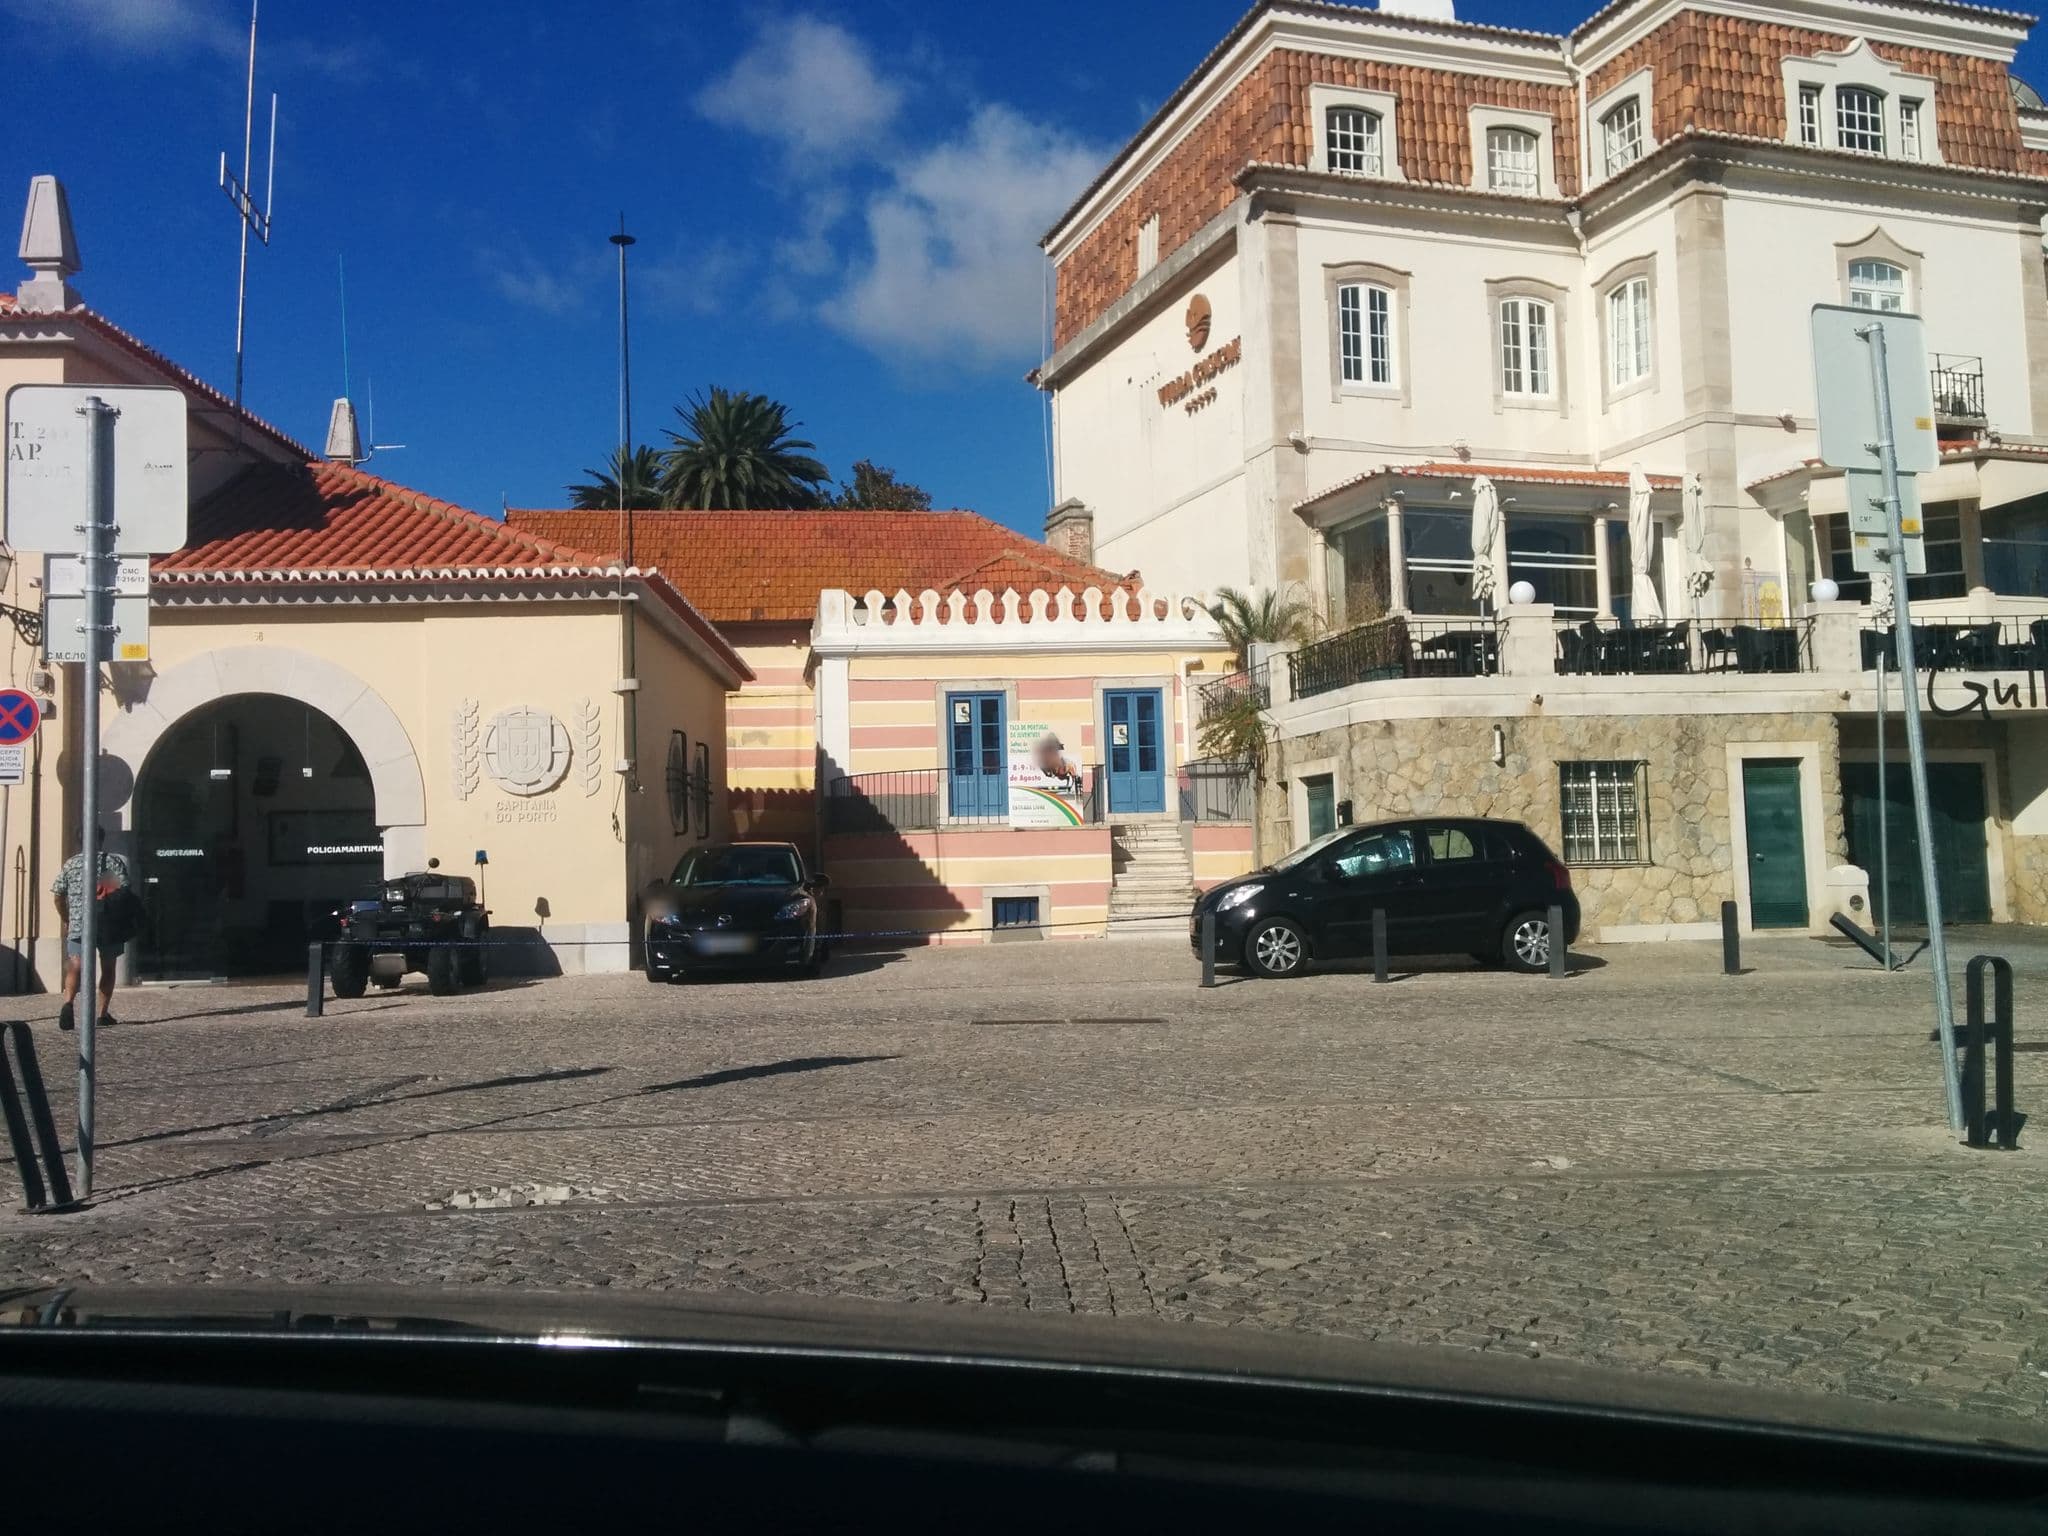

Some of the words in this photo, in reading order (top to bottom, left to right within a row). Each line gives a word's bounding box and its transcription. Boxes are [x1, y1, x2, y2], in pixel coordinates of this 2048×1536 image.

[496, 800, 557, 811] CAPITANIA
[496, 812, 512, 823] DO
[518, 812, 557, 823] PORTO
